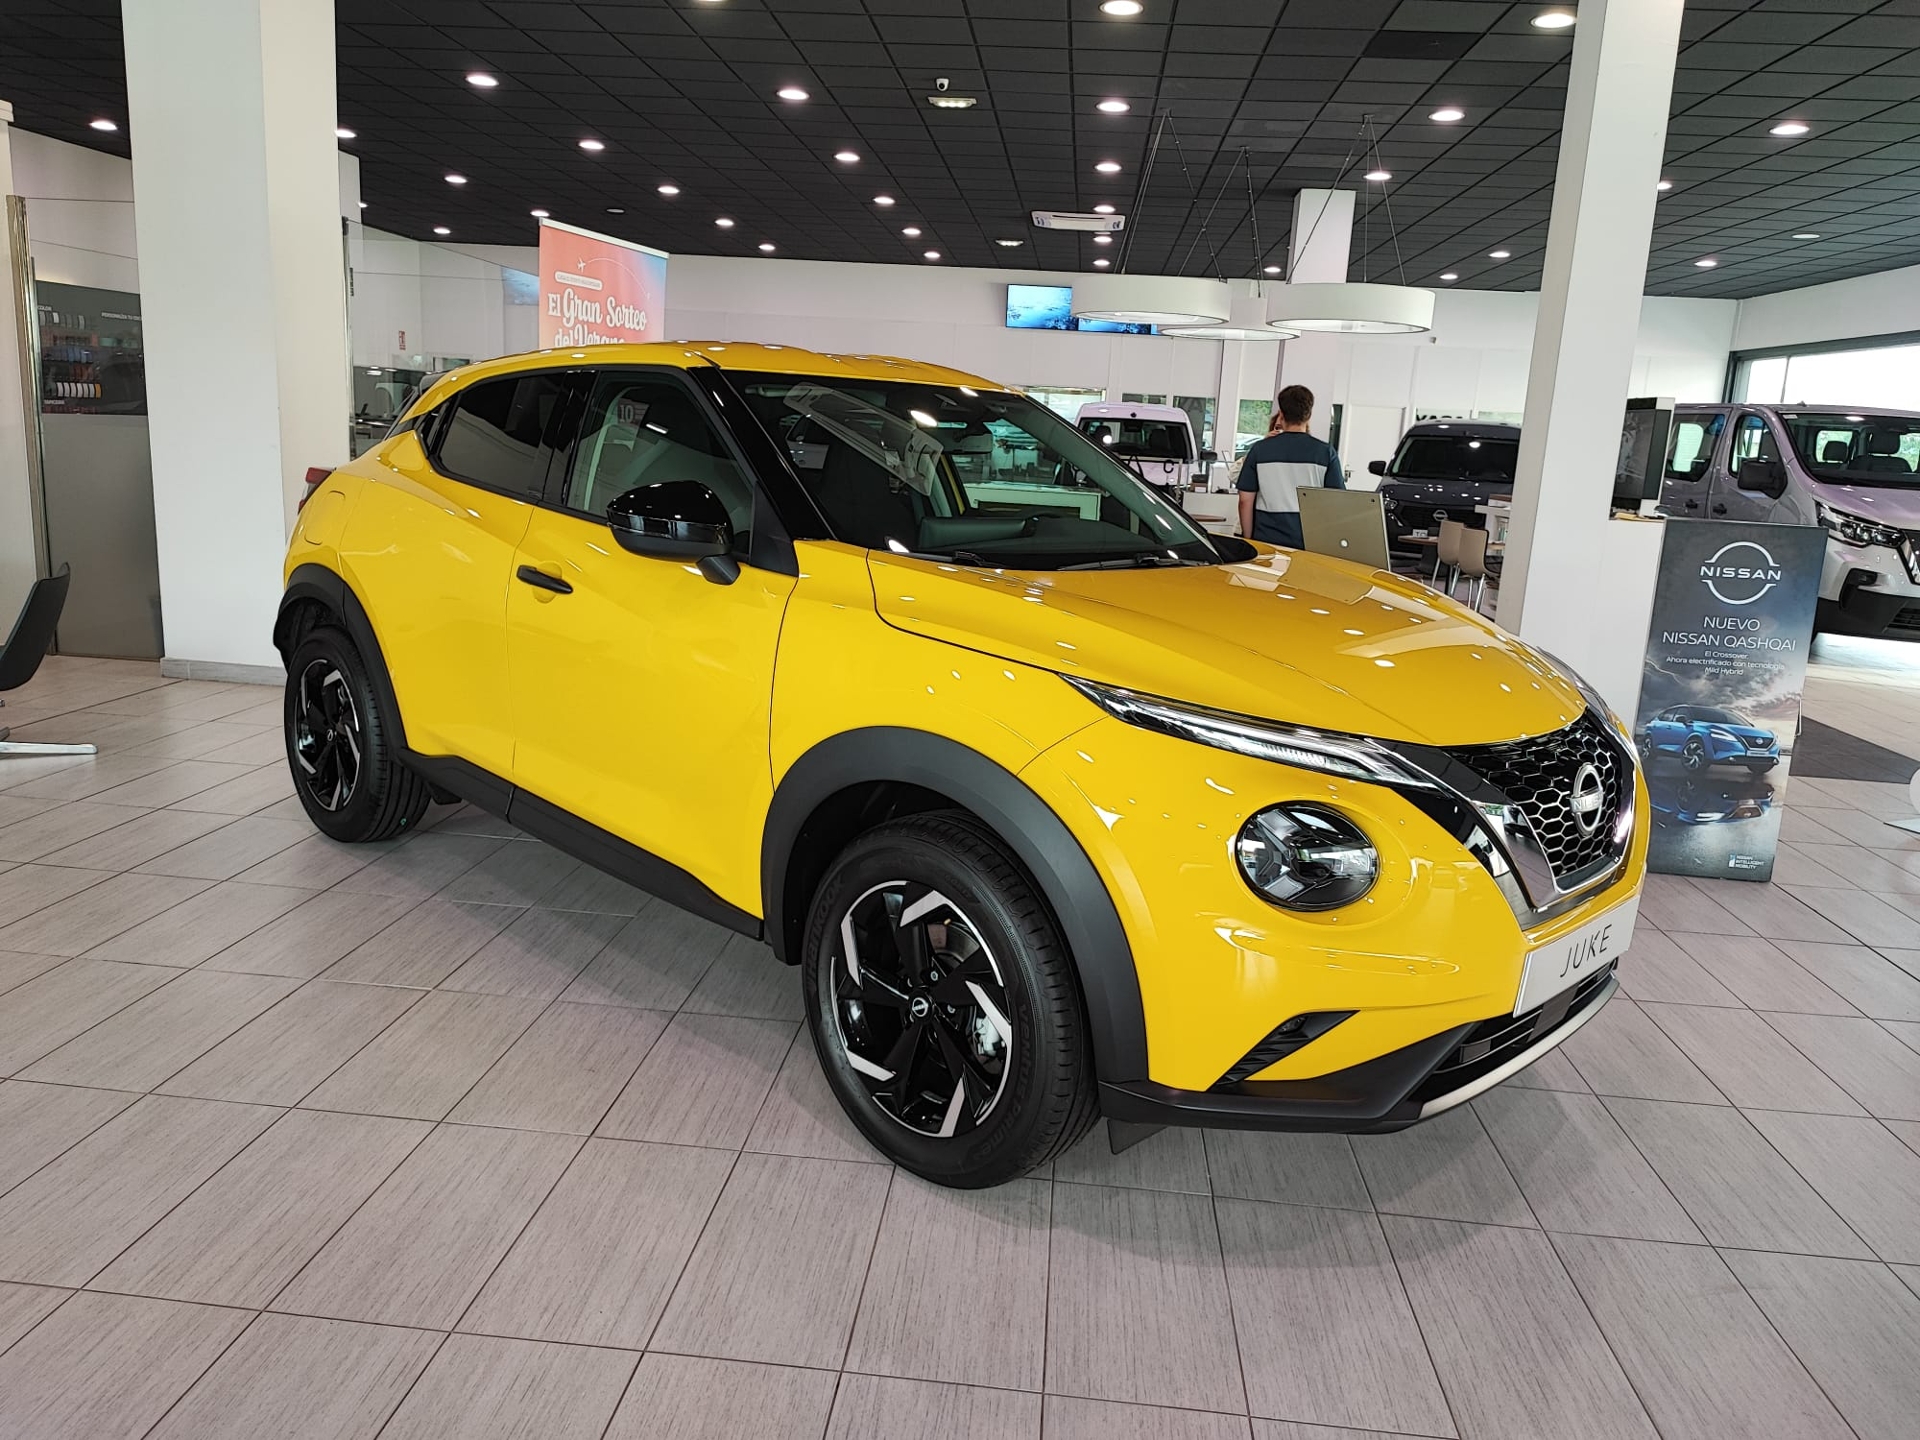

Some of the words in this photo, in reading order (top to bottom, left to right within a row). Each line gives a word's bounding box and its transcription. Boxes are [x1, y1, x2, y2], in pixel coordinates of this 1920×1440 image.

[548, 293, 561, 317] El
[563, 288, 603, 328] Gran
[606, 296, 647, 331] Sorteo
[554, 328, 574, 347] del
[574, 324, 625, 347] Vera
[619, 404, 634, 423] 10
[1700, 565, 1781, 581] NISSAN
[1703, 616, 1761, 631] NUEVO
[1662, 631, 1720, 647] NISSAN
[1723, 635, 1797, 652] QASHQAI
[1666, 656, 1688, 664] Ahora
[1688, 657, 1732, 667] electrificado
[1704, 666, 1719, 674] Mild
[1720, 667, 1744, 676] Hybrid
[1559, 923, 1613, 978] JUKE
